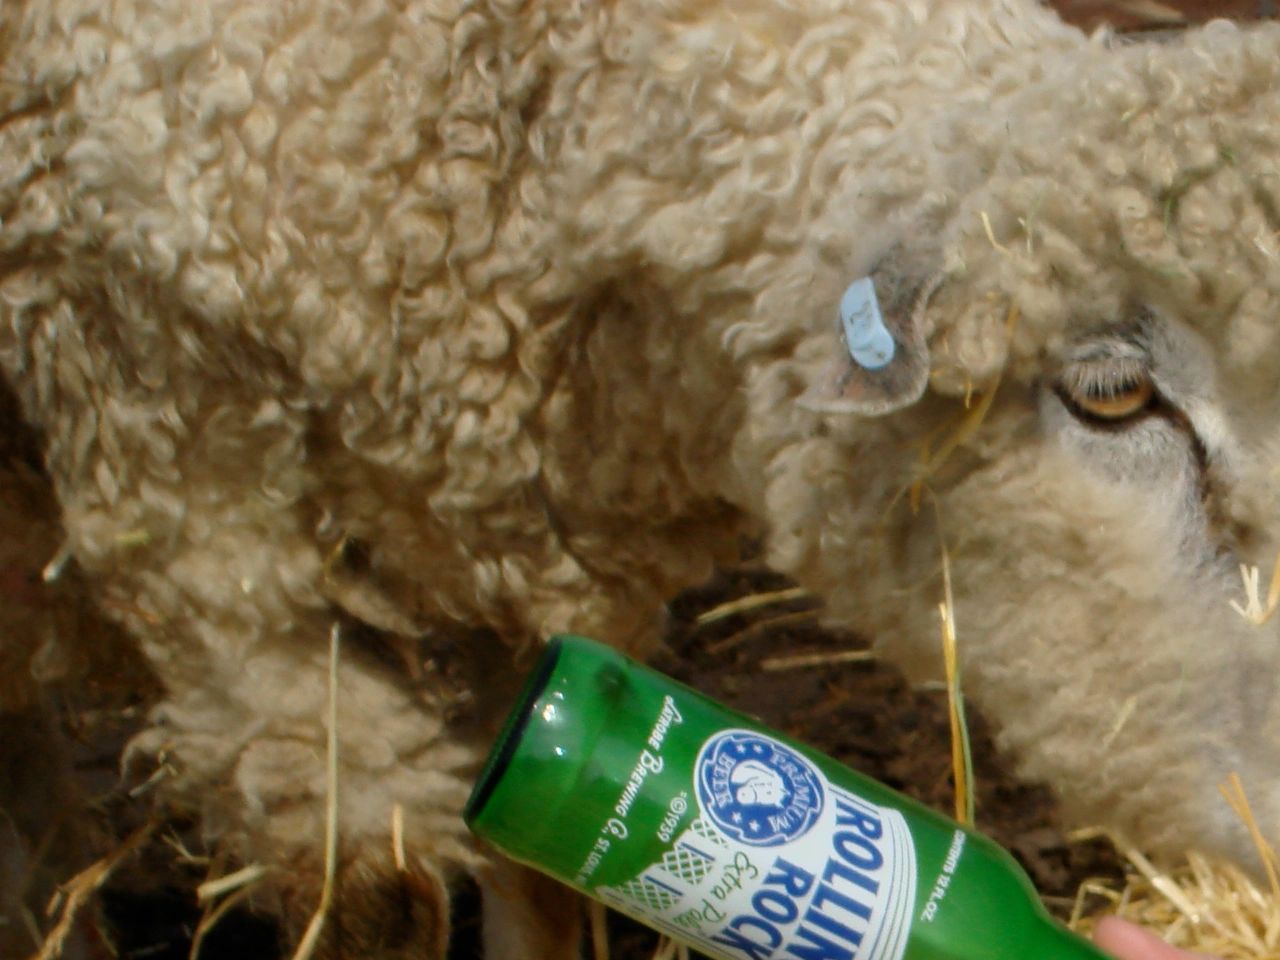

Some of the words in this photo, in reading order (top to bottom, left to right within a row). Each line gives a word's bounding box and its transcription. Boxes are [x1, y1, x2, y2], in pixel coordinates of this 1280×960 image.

[615, 749, 664, 818] BREWING
[712, 752, 736, 808] BEER
[768, 752, 810, 833] PREMIUM
[710, 851, 758, 900] Extra
